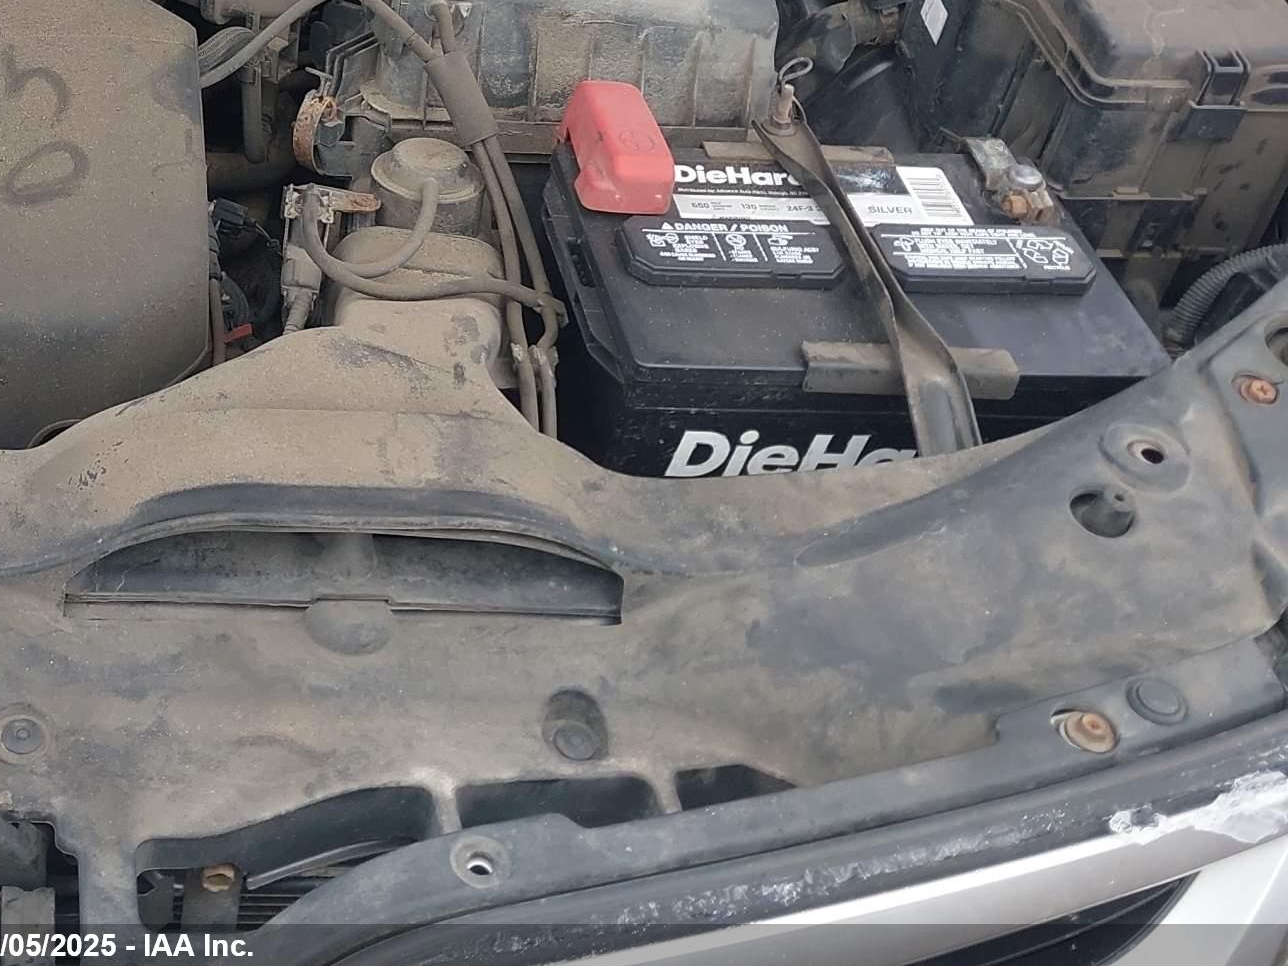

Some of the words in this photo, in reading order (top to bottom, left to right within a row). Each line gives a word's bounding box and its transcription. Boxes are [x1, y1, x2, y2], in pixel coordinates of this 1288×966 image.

[868, 205, 913, 214] SILVER
[674, 222, 728, 232] DANGER
[740, 224, 789, 233] POISON
[664, 429, 917, 477] DieHa
